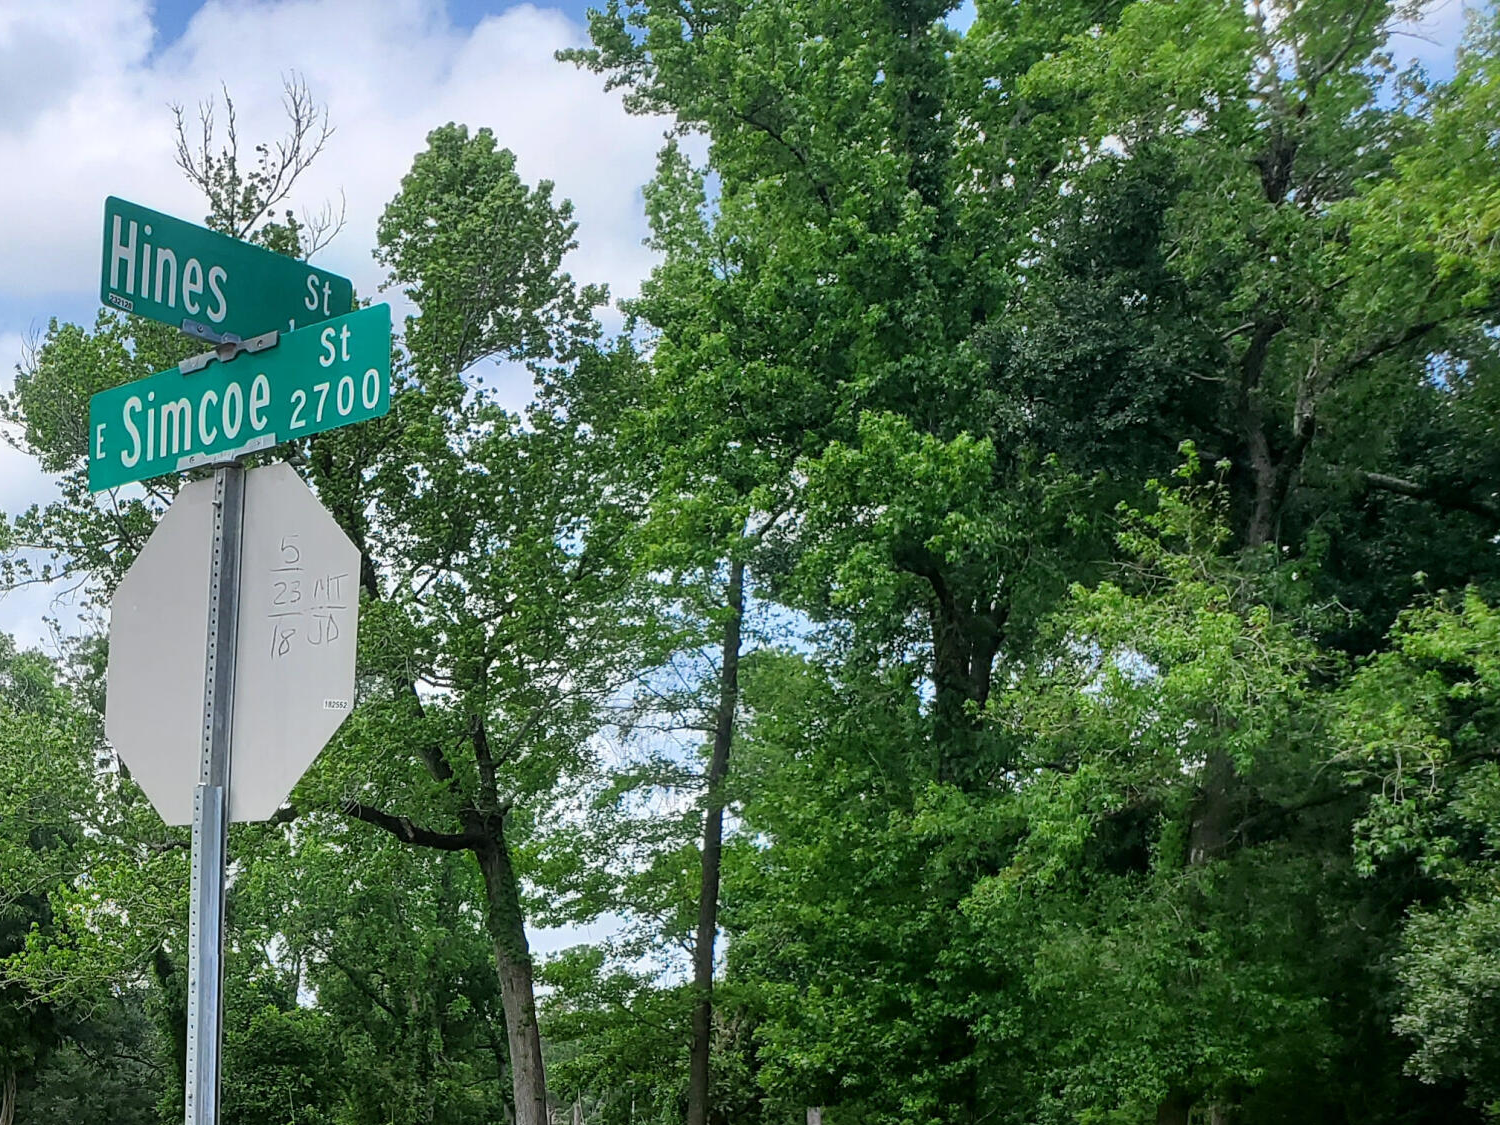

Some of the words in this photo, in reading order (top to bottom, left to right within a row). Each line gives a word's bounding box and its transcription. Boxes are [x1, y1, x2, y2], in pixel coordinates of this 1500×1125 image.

[109, 214, 228, 323] Hines
[304, 274, 332, 316] St
[318, 324, 351, 367] St
[289, 368, 381, 430] 2700
[96, 423, 106, 459] E
[120, 374, 271, 468] Simcoe
[280, 534, 299, 564] 5
[273, 580, 301, 605] 23
[271, 624, 296, 660] 18
